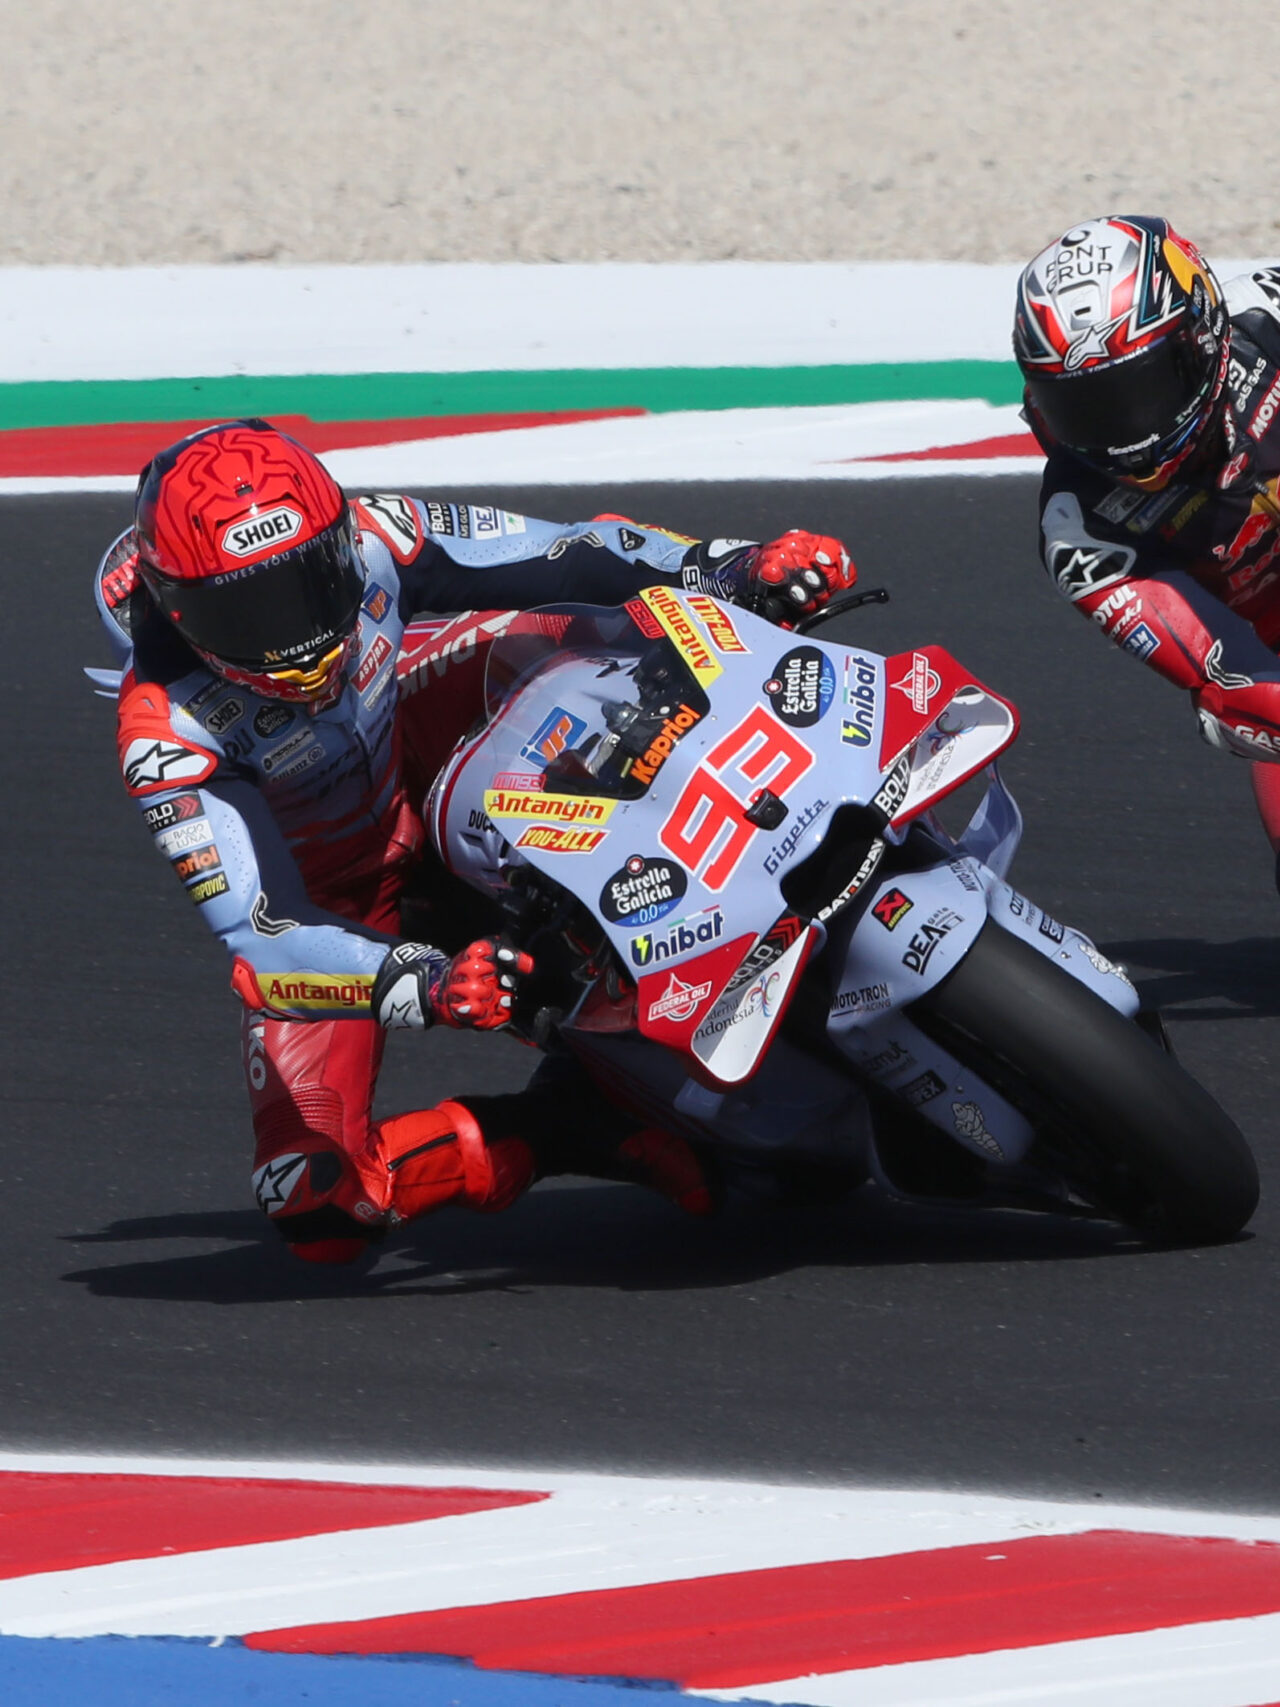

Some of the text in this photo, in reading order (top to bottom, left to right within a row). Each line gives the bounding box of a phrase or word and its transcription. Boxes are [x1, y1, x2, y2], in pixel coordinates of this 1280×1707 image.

[1236, 357, 1267, 413] GASGAS
[214, 529, 335, 586] GIVES YOU WINGS
[232, 513, 293, 551] SHOEI
[647, 586, 716, 669] Antangin
[1092, 584, 1137, 626] OTUL
[280, 629, 335, 658] VERTICAL
[399, 626, 478, 700] DAIK
[781, 657, 802, 716] Estrella
[800, 659, 820, 713] Galicia
[841, 653, 877, 748] Unibat
[914, 656, 928, 712] FEDERAL OIL
[208, 700, 241, 731] SHOEI
[630, 702, 701, 785] Kapriol
[489, 793, 605, 821] Antangin
[659, 702, 816, 894] 93
[873, 756, 911, 813] BOLD
[176, 834, 207, 849] LUNA
[468, 809, 500, 834] DUC
[521, 827, 601, 851] YOU-ALL
[762, 798, 832, 876] Gigetta
[610, 866, 672, 899] Estrella
[616, 884, 673, 915] Galicia
[631, 911, 725, 967] Unibat
[902, 923, 949, 973] DEA
[652, 987, 708, 1018] FEDERAL OIL
[695, 1004, 755, 1041] ndonesia
[830, 982, 890, 1011] MOTO-TRON
[247, 1010, 267, 1090] IKO
